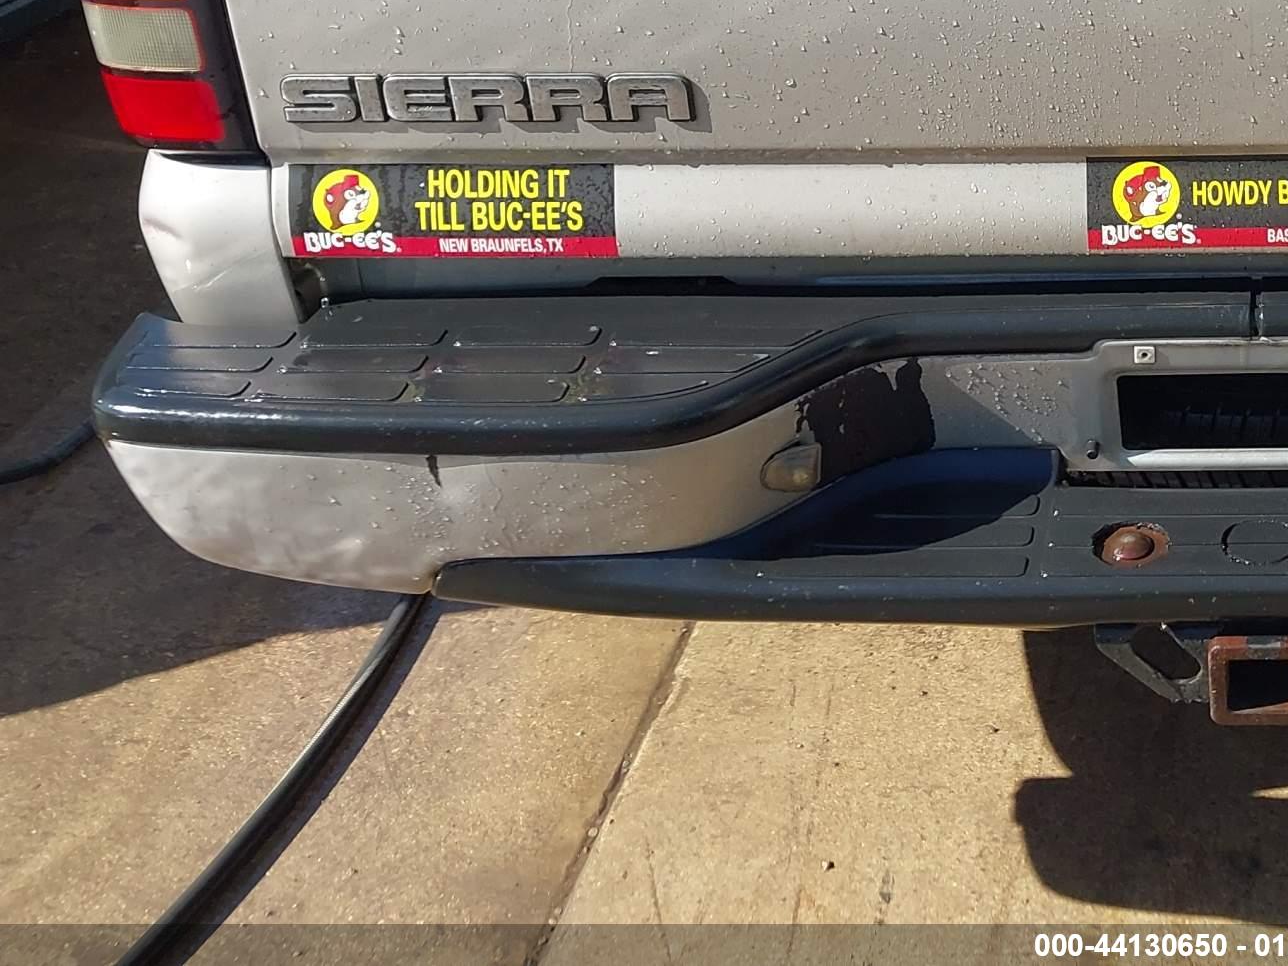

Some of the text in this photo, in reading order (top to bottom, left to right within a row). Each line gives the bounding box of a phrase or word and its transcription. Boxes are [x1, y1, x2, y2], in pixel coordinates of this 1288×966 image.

[280, 73, 698, 123] SIERRA
[427, 169, 570, 199] HOLDING IT
[1192, 180, 1272, 206] HOWDY
[414, 201, 583, 231] TILL BUC-EE'S
[438, 238, 469, 253] NEW
